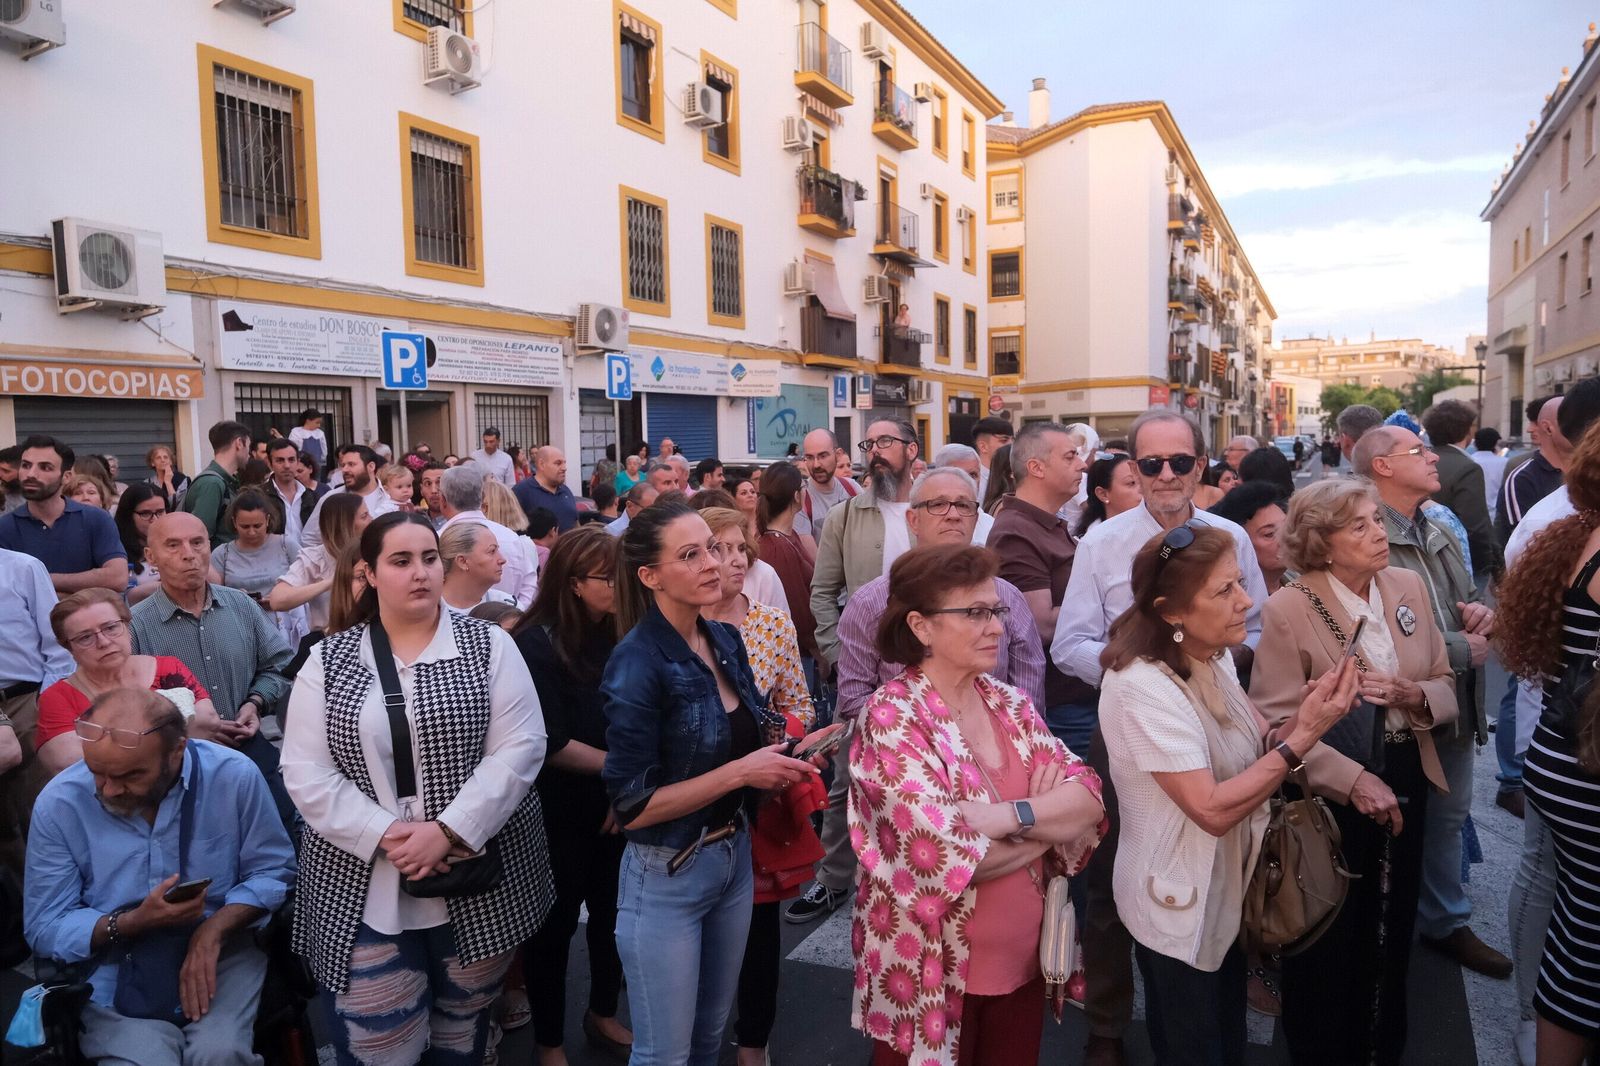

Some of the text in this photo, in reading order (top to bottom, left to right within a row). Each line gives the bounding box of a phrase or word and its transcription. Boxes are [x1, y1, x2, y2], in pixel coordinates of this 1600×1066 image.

[40, 1, 53, 12] LG
[252, 315, 278, 328] Centro
[279, 318, 288, 328] de
[289, 319, 317, 331] estudios
[319, 316, 344, 333] DON
[347, 320, 381, 337] BOSCO
[437, 335, 460, 345] CENTRO
[504, 341, 560, 354] LEPANTO
[390, 338, 418, 383] P
[0, 365, 191, 398] FOTOCOPIAS
[611, 359, 627, 395] P
[859, 376, 870, 392] L
